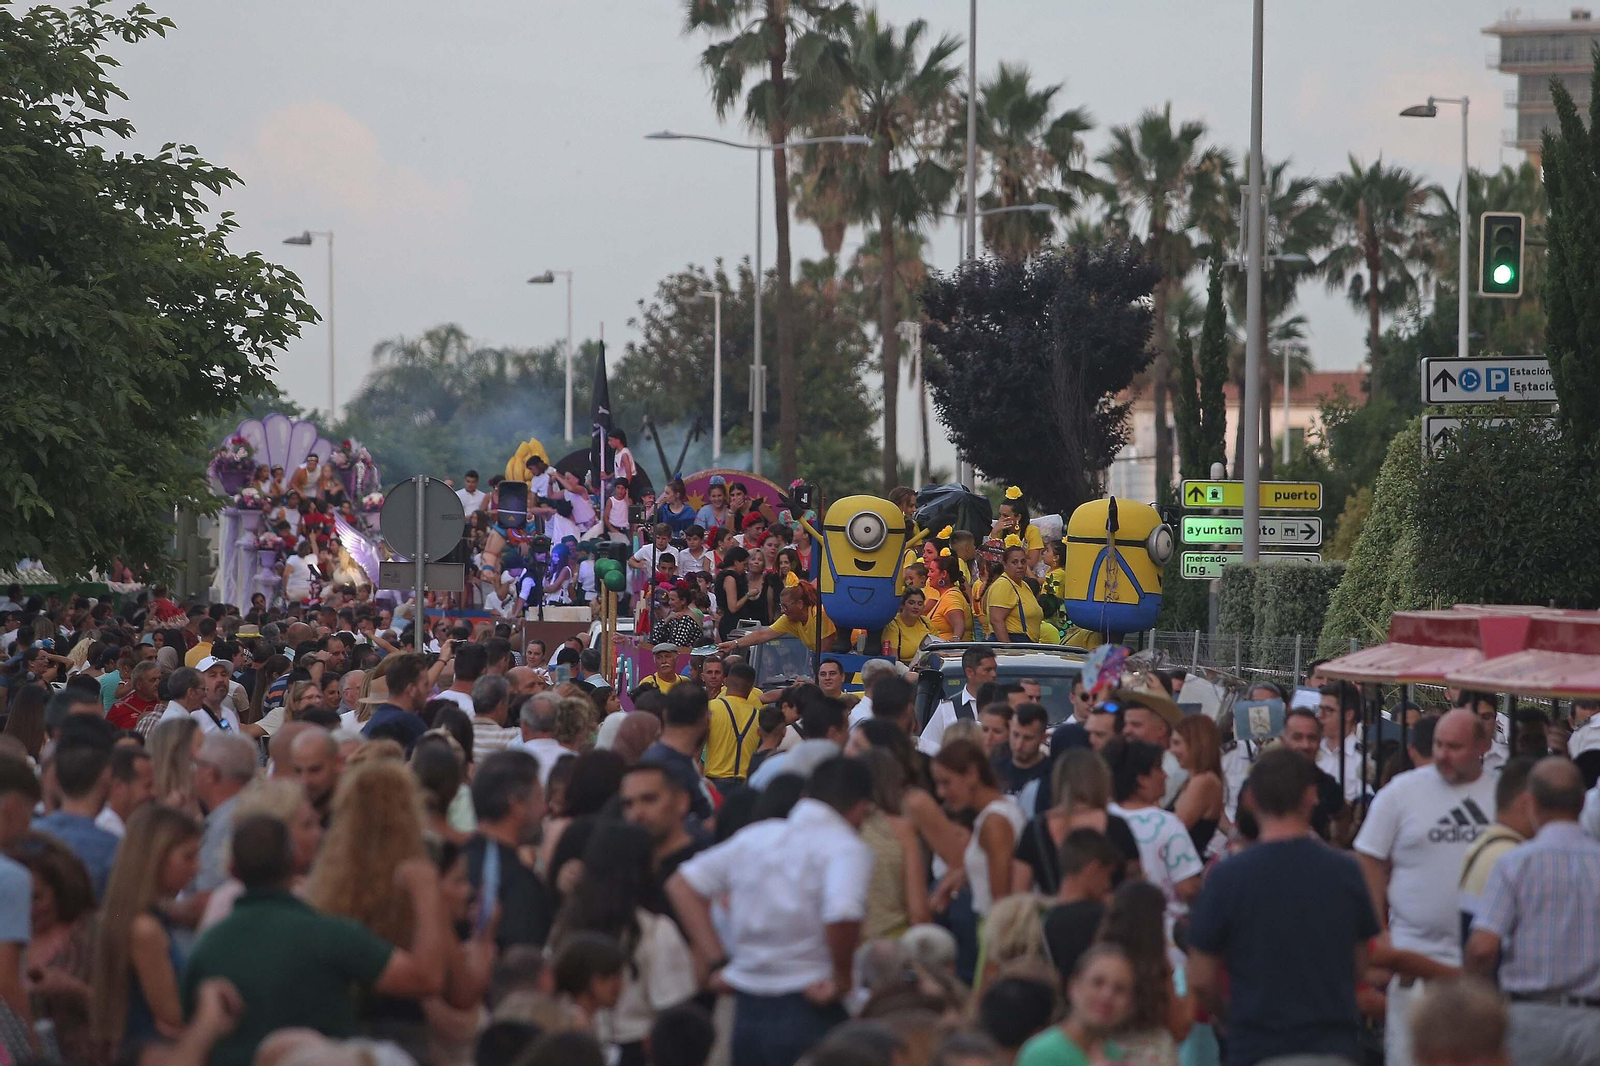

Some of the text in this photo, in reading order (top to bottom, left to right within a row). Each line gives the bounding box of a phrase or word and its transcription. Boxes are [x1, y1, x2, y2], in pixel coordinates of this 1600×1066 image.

[1510, 367, 1551, 376] Estación
[1491, 370, 1505, 390] P
[1514, 381, 1555, 391] Estació
[1274, 490, 1317, 502] puerto
[1187, 523, 1276, 536] ayuntamto
[1186, 555, 1228, 563] mercado
[1186, 564, 1210, 575] Ing.
[1427, 826, 1481, 843] adid
